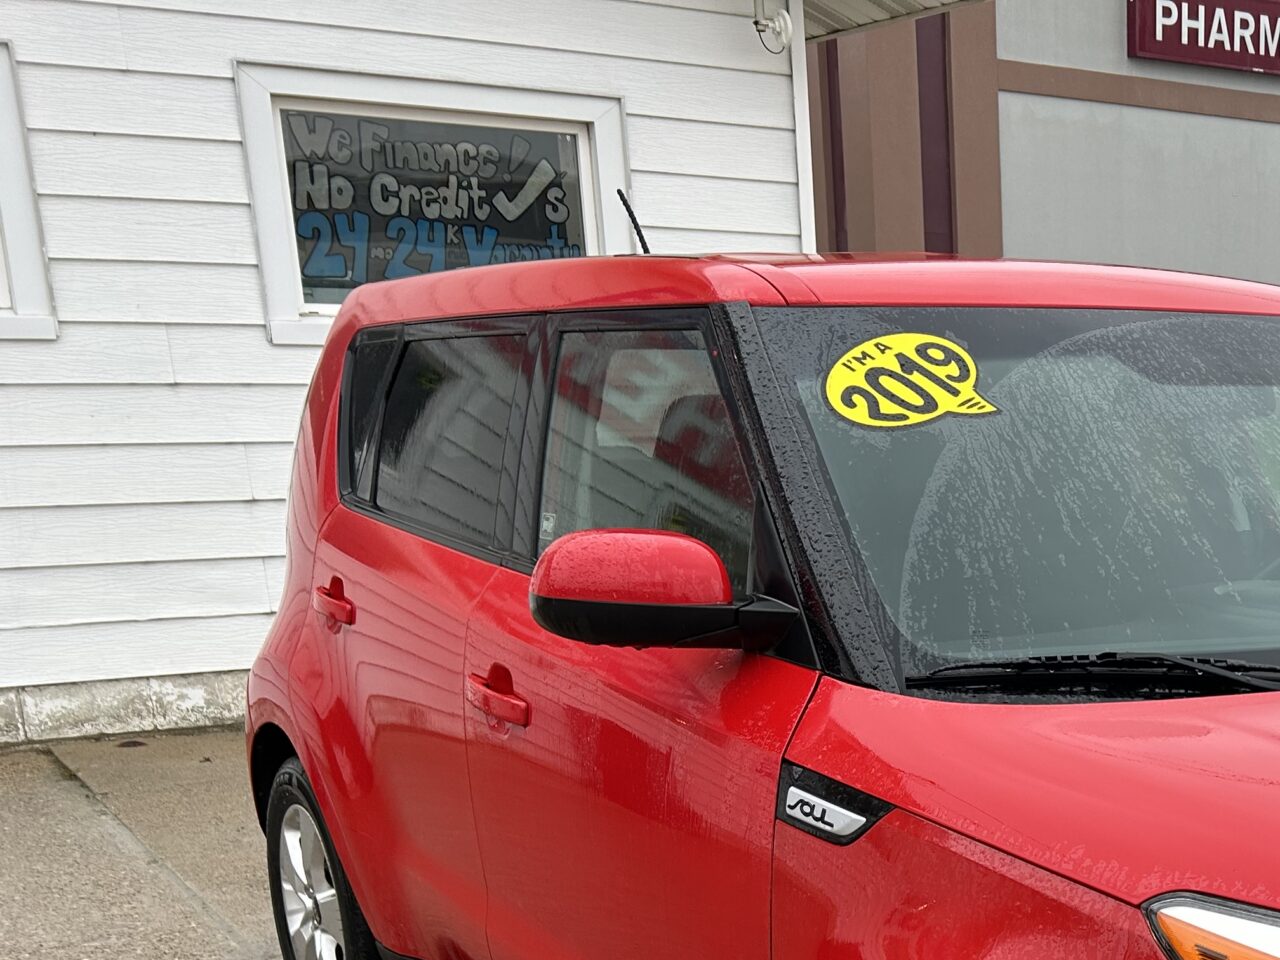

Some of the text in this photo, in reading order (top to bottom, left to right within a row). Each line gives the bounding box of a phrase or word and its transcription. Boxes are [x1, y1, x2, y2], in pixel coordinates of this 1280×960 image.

[286, 114, 353, 165] We
[294, 160, 355, 210] No
[368, 172, 492, 222] Credit
[297, 211, 371, 283] 24
[384, 216, 447, 279] 24
[840, 341, 971, 422] 2019
[841, 341, 893, 372] I'M A
